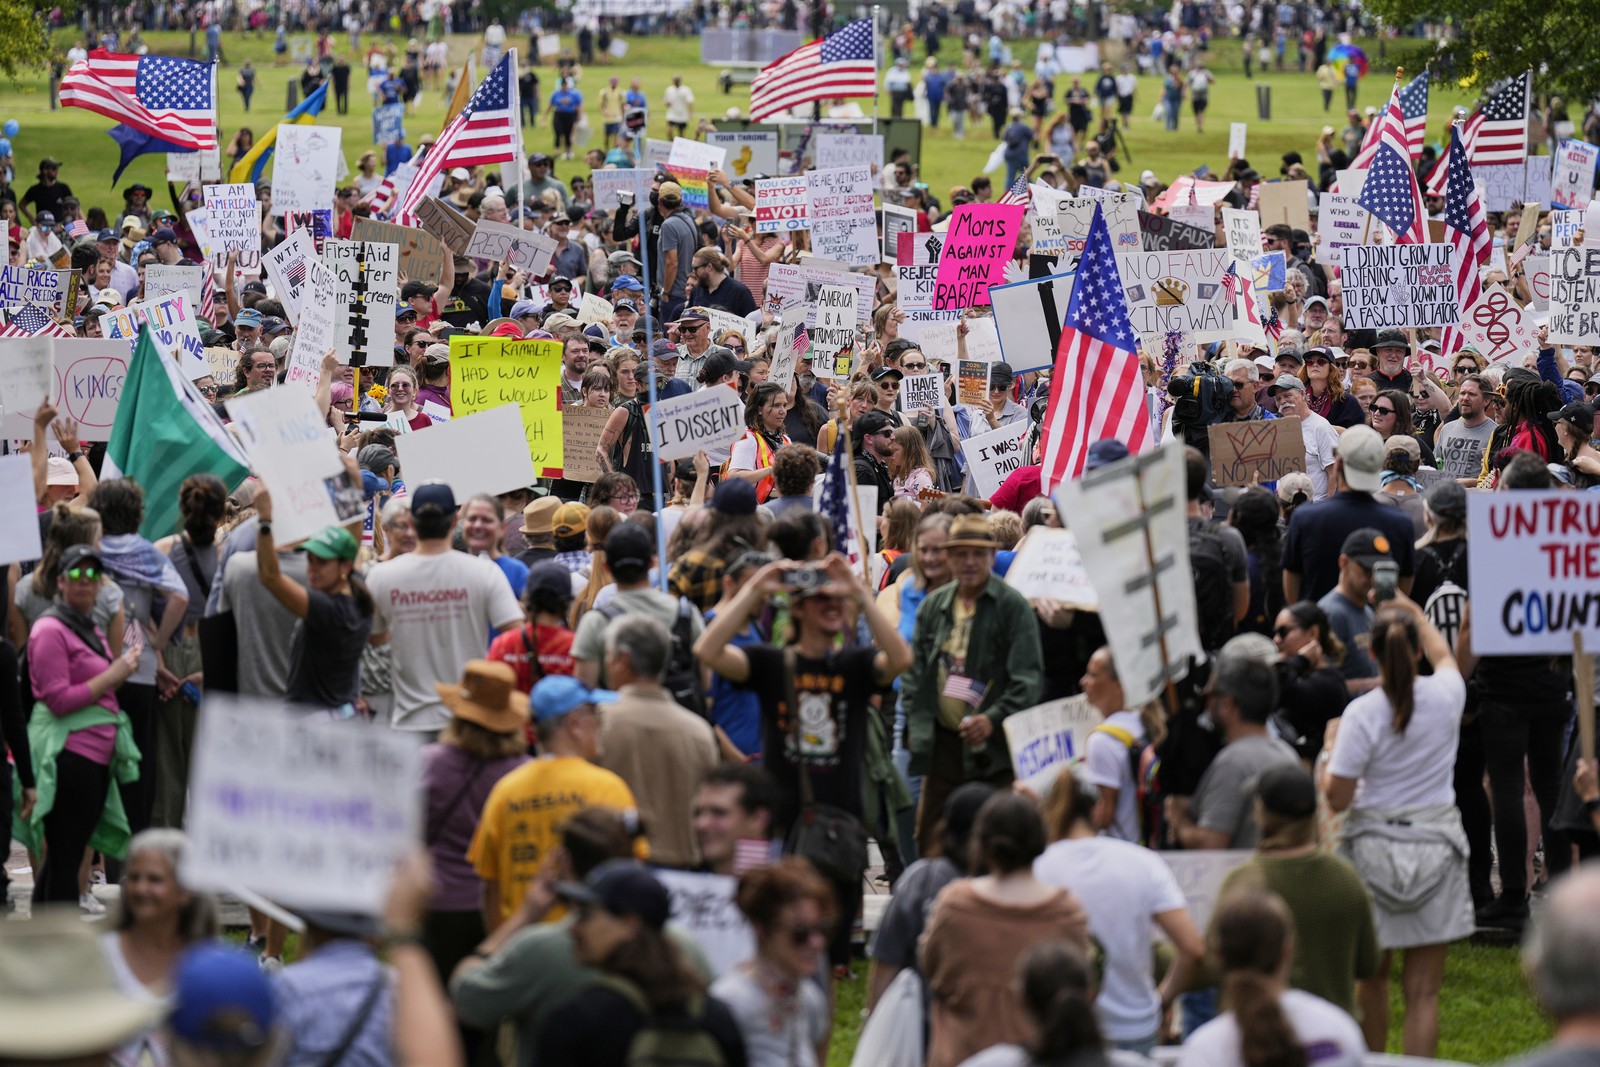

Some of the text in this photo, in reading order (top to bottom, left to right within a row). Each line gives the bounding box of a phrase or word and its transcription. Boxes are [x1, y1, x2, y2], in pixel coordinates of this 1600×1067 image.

[808, 174, 818, 187] WE
[834, 170, 868, 184] WITNESS
[1568, 171, 1579, 184] U
[208, 185, 245, 197] I AM
[758, 186, 806, 198] STUP
[829, 184, 855, 194] TO YOUR
[206, 200, 256, 210] AMERICAN
[1111, 194, 1126, 203] ICE
[210, 210, 256, 219] I DO NOT
[1330, 208, 1350, 216] WHO
[1554, 211, 1570, 224] WE
[759, 222, 780, 232] IT
[1036, 218, 1054, 226] YOU
[1138, 210, 1214, 248] NO FAUX
[1334, 221, 1360, 229] LEGAL
[210, 228, 258, 238] I KNOW NO
[274, 240, 300, 265] WTF
[326, 242, 390, 262] First Aid
[945, 244, 1006, 260] AGAINST
[1344, 244, 1454, 268] I DIDNT GROW UP
[280, 253, 307, 276] AMERICA
[1125, 252, 1226, 280] NO FAUX
[1551, 247, 1600, 280] ICE
[0, 265, 58, 288] ALL RACES
[148, 269, 168, 278] ELVIS
[778, 268, 798, 276] STOP
[958, 264, 991, 280] MAN
[1340, 264, 1452, 288] LISTENING TO PUNK
[146, 282, 170, 292] DOLLY
[1418, 275, 1453, 286] ROCK
[0, 282, 21, 301] ALL
[819, 289, 852, 308] AMERICA
[1342, 284, 1454, 308] TO BOW DOWN TO
[911, 310, 963, 321] SINCE 1776
[1186, 302, 1228, 331] WAY
[1344, 302, 1460, 328] A FASCIST DICTATOR
[1564, 303, 1580, 314] TO
[825, 312, 842, 326] IS A
[1550, 314, 1574, 335] LUKE
[814, 327, 855, 346] TRUMPSTER
[176, 332, 204, 361] ONE
[458, 342, 551, 360] IF KAMALA
[220, 353, 237, 368] the
[812, 350, 831, 370] FIRE
[460, 366, 540, 382] HAD WON
[906, 376, 938, 392] I HAVE
[461, 388, 548, 406] WE WOULD
[906, 389, 939, 402] FRIENDS
[907, 400, 940, 410] EVERYERE
[657, 421, 668, 448] I
[675, 404, 740, 442] DISSENT
[1446, 436, 1480, 450] VOTE
[979, 447, 990, 462] I
[1444, 448, 1477, 462] VOTE
[994, 456, 1020, 475] PAID
[1222, 456, 1300, 484] NO KINGS
[1539, 541, 1600, 580] THE
[390, 588, 468, 606] PATAGONIA
